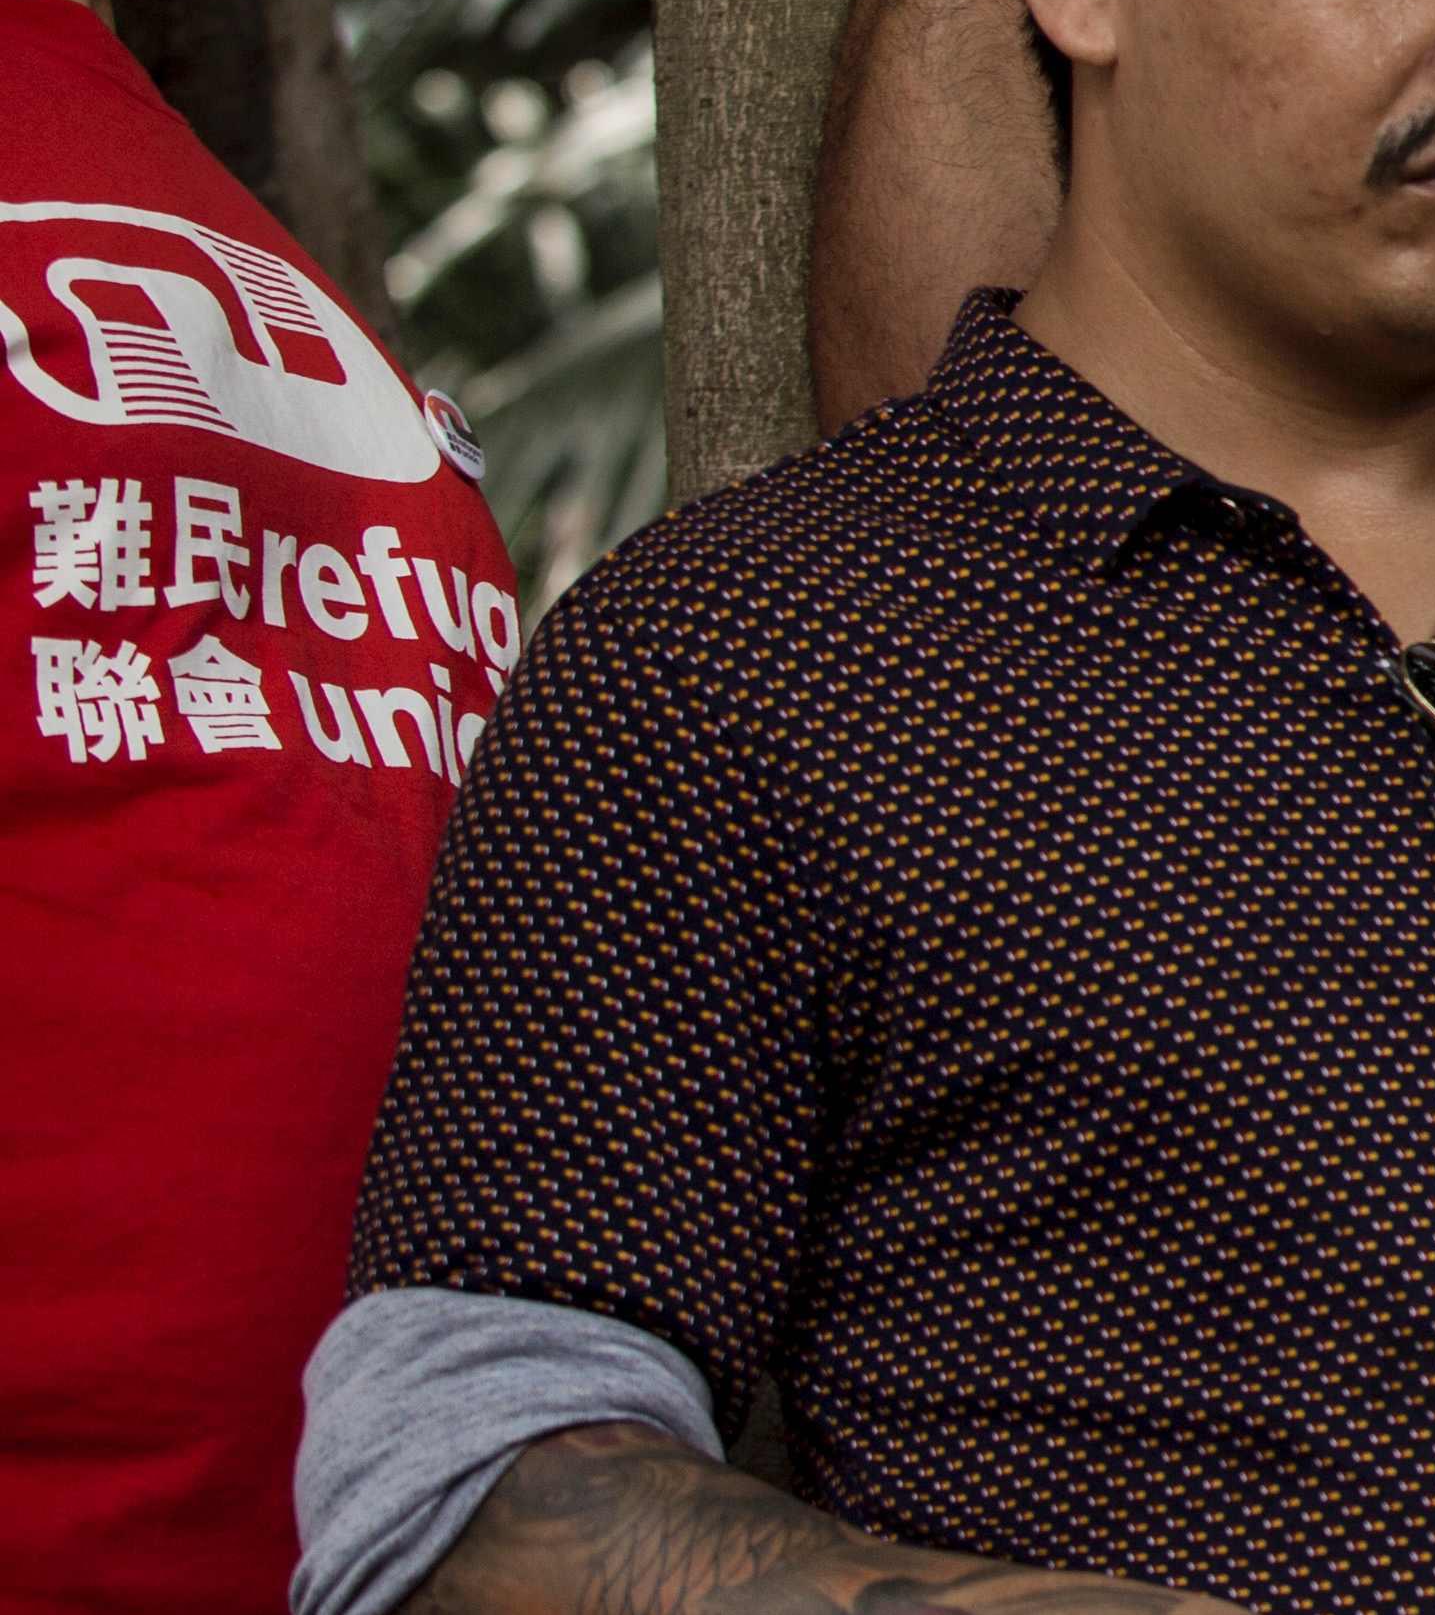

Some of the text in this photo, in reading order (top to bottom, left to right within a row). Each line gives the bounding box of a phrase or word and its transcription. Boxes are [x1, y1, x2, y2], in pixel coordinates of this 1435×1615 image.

[28, 475, 522, 696] 難民 refug
[30, 633, 283, 763] 聯會
